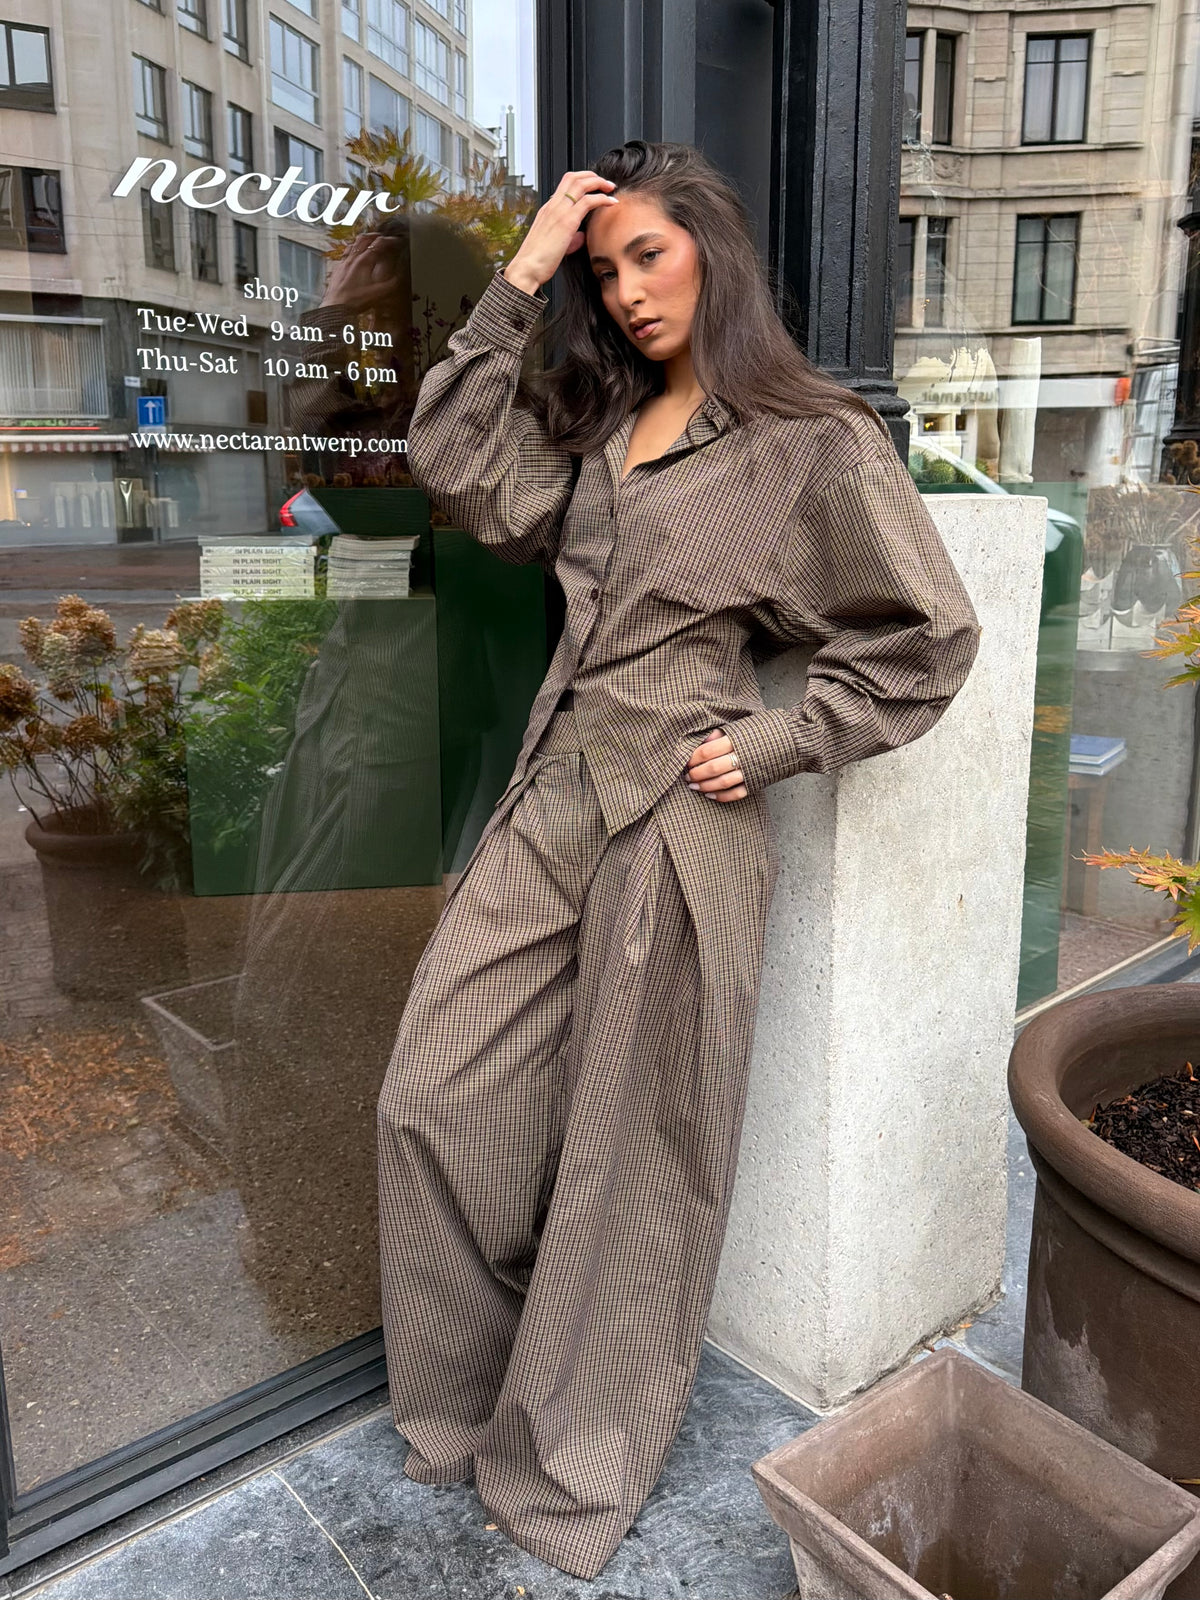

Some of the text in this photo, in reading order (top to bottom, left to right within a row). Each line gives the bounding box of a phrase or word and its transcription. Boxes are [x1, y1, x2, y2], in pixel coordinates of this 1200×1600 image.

[112, 156, 401, 227] nectar
[243, 277, 299, 307] shop
[136, 307, 250, 338] Tue-Wed
[271, 319, 285, 342] 9
[289, 324, 325, 346] am
[341, 323, 356, 346] 6
[359, 329, 394, 353] pm
[136, 346, 240, 376] Thu-Sat
[263, 357, 290, 379] 10
[294, 361, 330, 381] am
[346, 360, 361, 382] 6
[364, 366, 399, 388] pm
[131, 431, 408, 457] www.nectarantwerp.com
